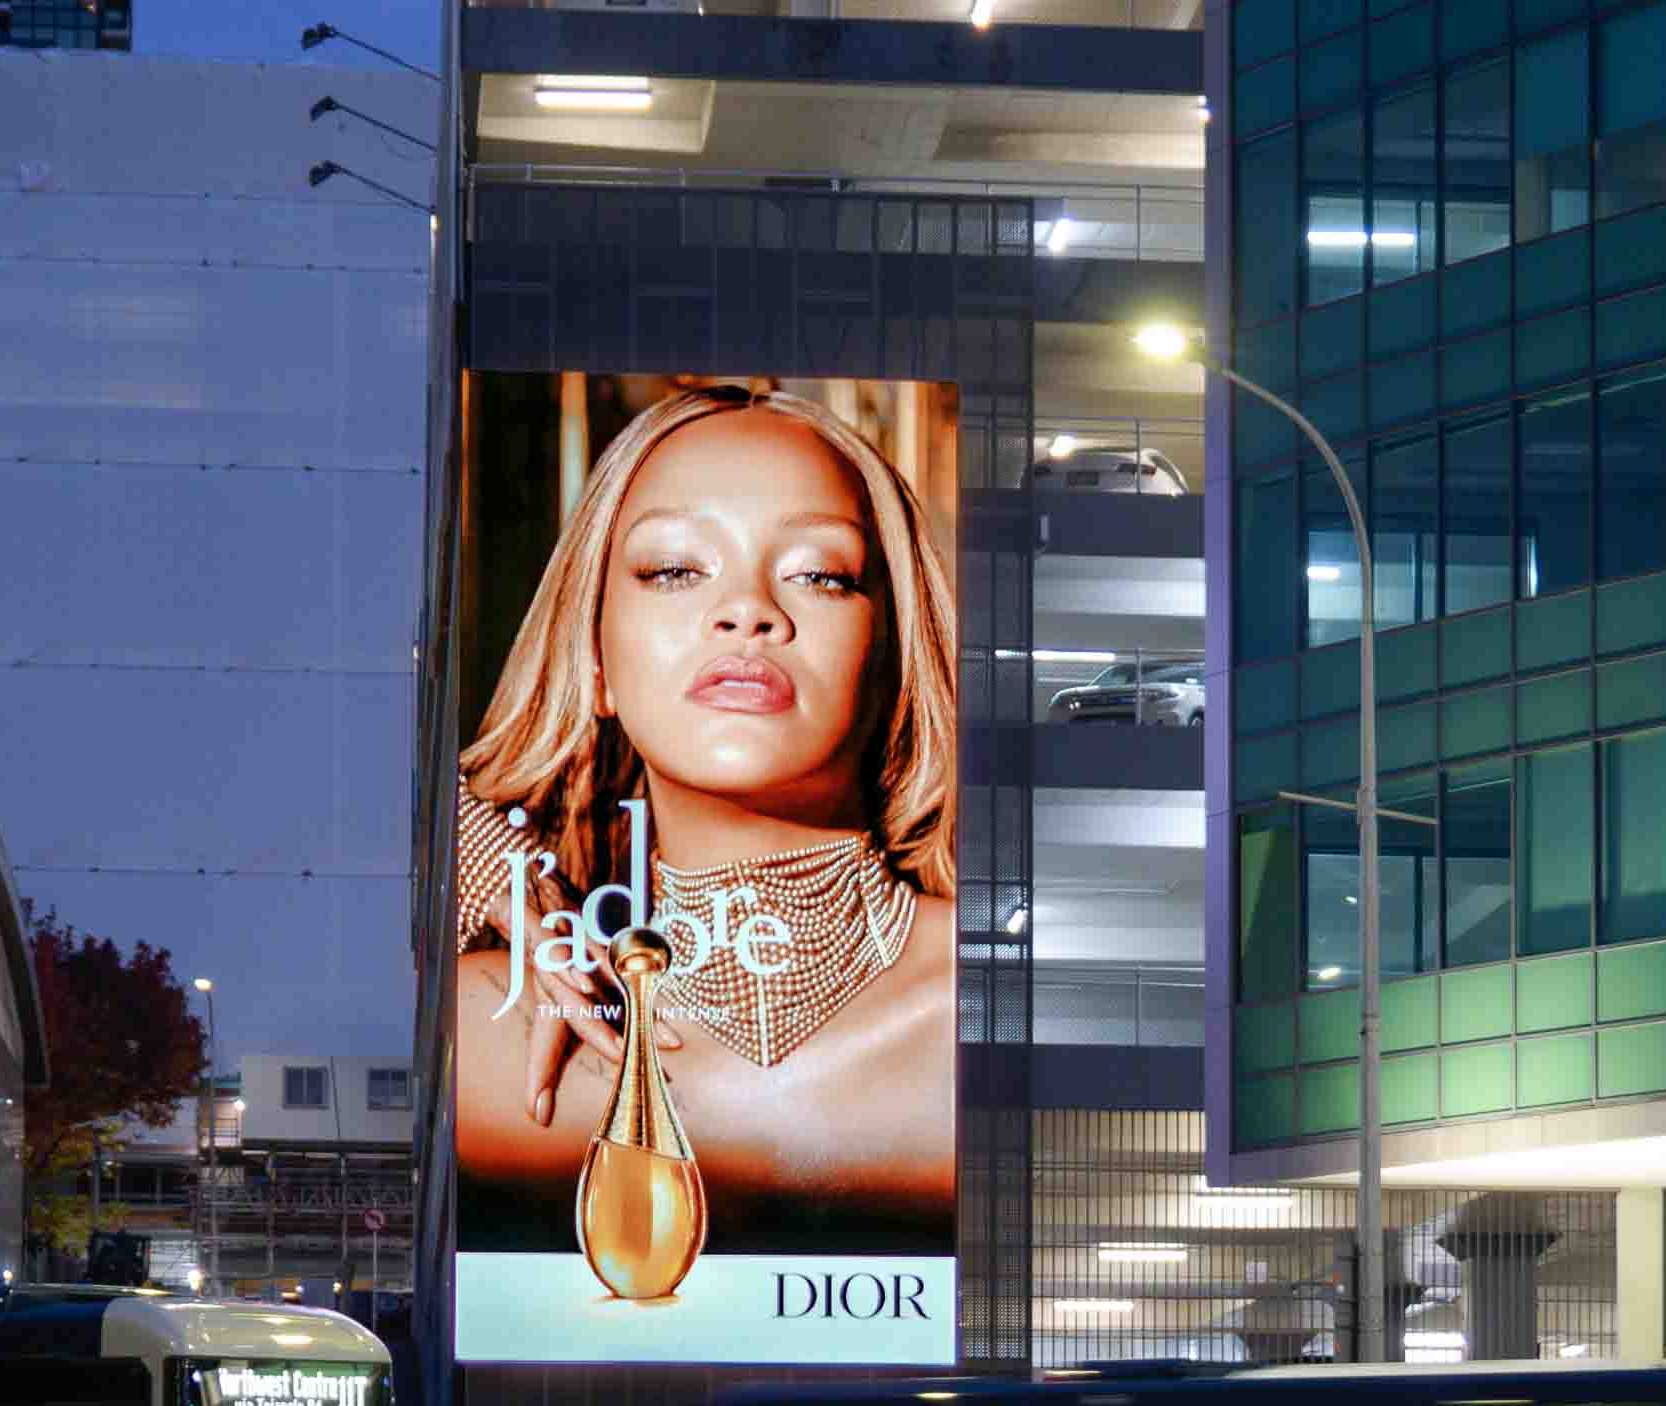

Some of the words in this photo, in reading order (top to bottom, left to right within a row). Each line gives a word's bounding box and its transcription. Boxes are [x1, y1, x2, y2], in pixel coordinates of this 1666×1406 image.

[537, 1004, 573, 1019] THE
[579, 1004, 621, 1020] NEW
[771, 1272, 932, 1320] DIOR
